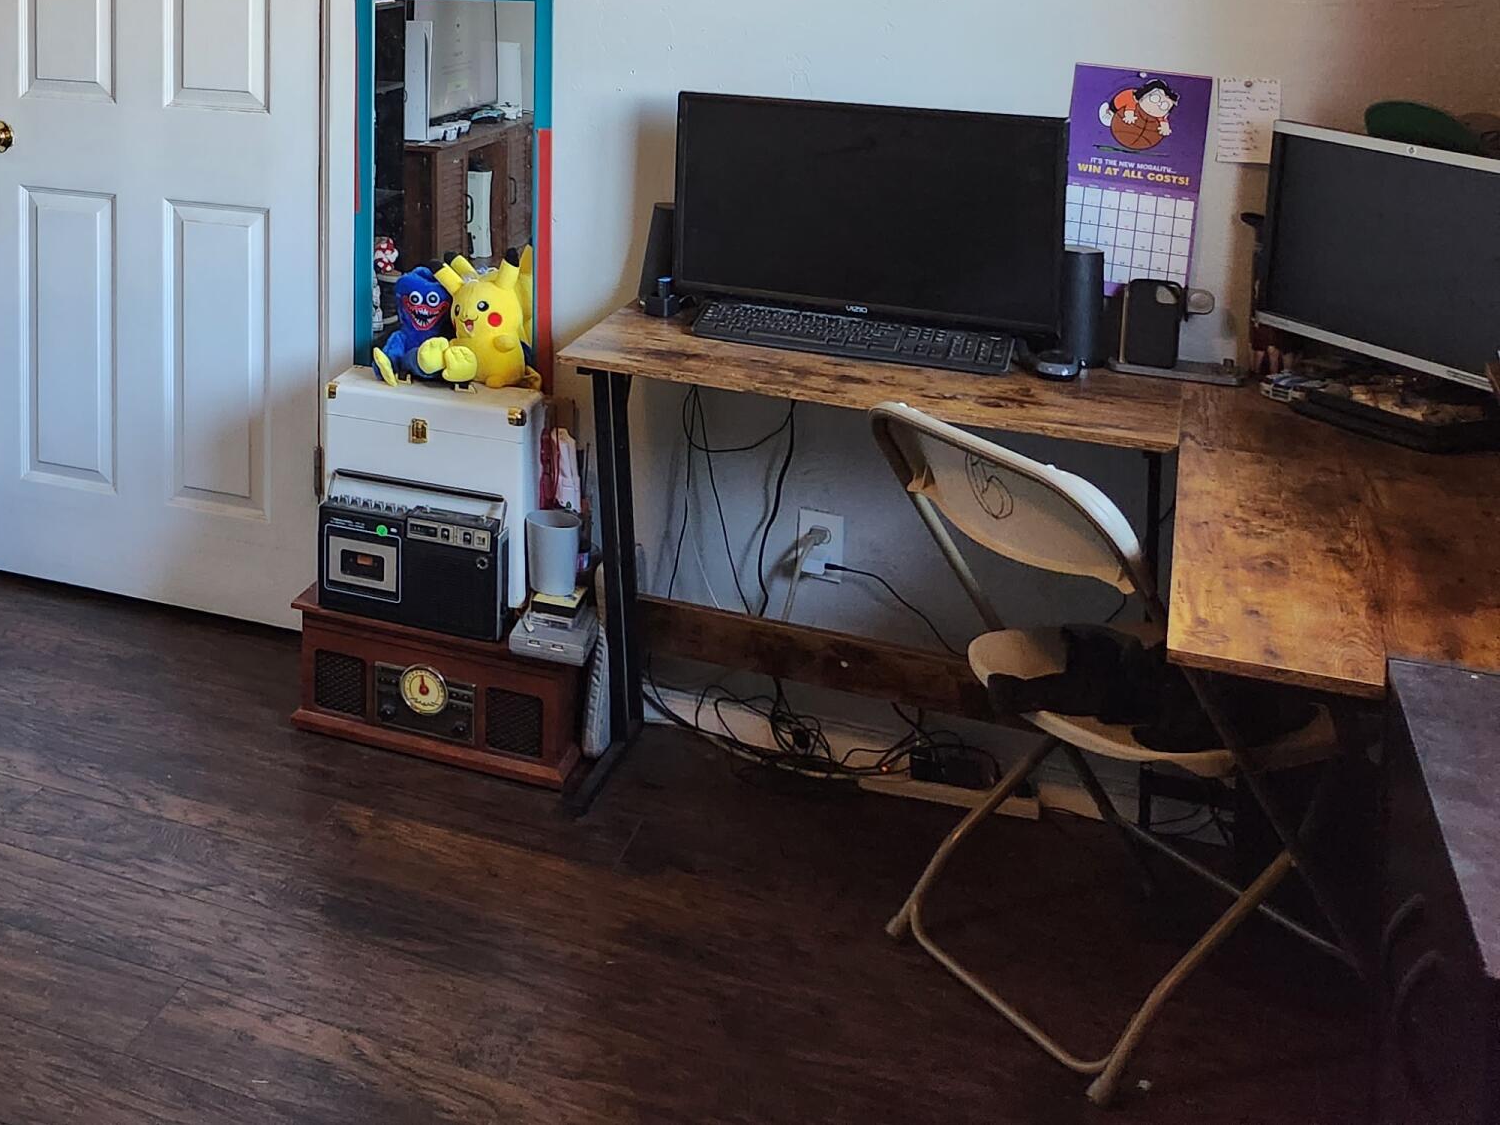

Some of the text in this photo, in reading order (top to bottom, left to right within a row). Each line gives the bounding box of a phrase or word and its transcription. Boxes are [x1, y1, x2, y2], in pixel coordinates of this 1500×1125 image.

[1104, 158, 1118, 166] THE
[1119, 161, 1136, 169] NEW
[1077, 163, 1190, 186] WIN AT ALL COSTS!
